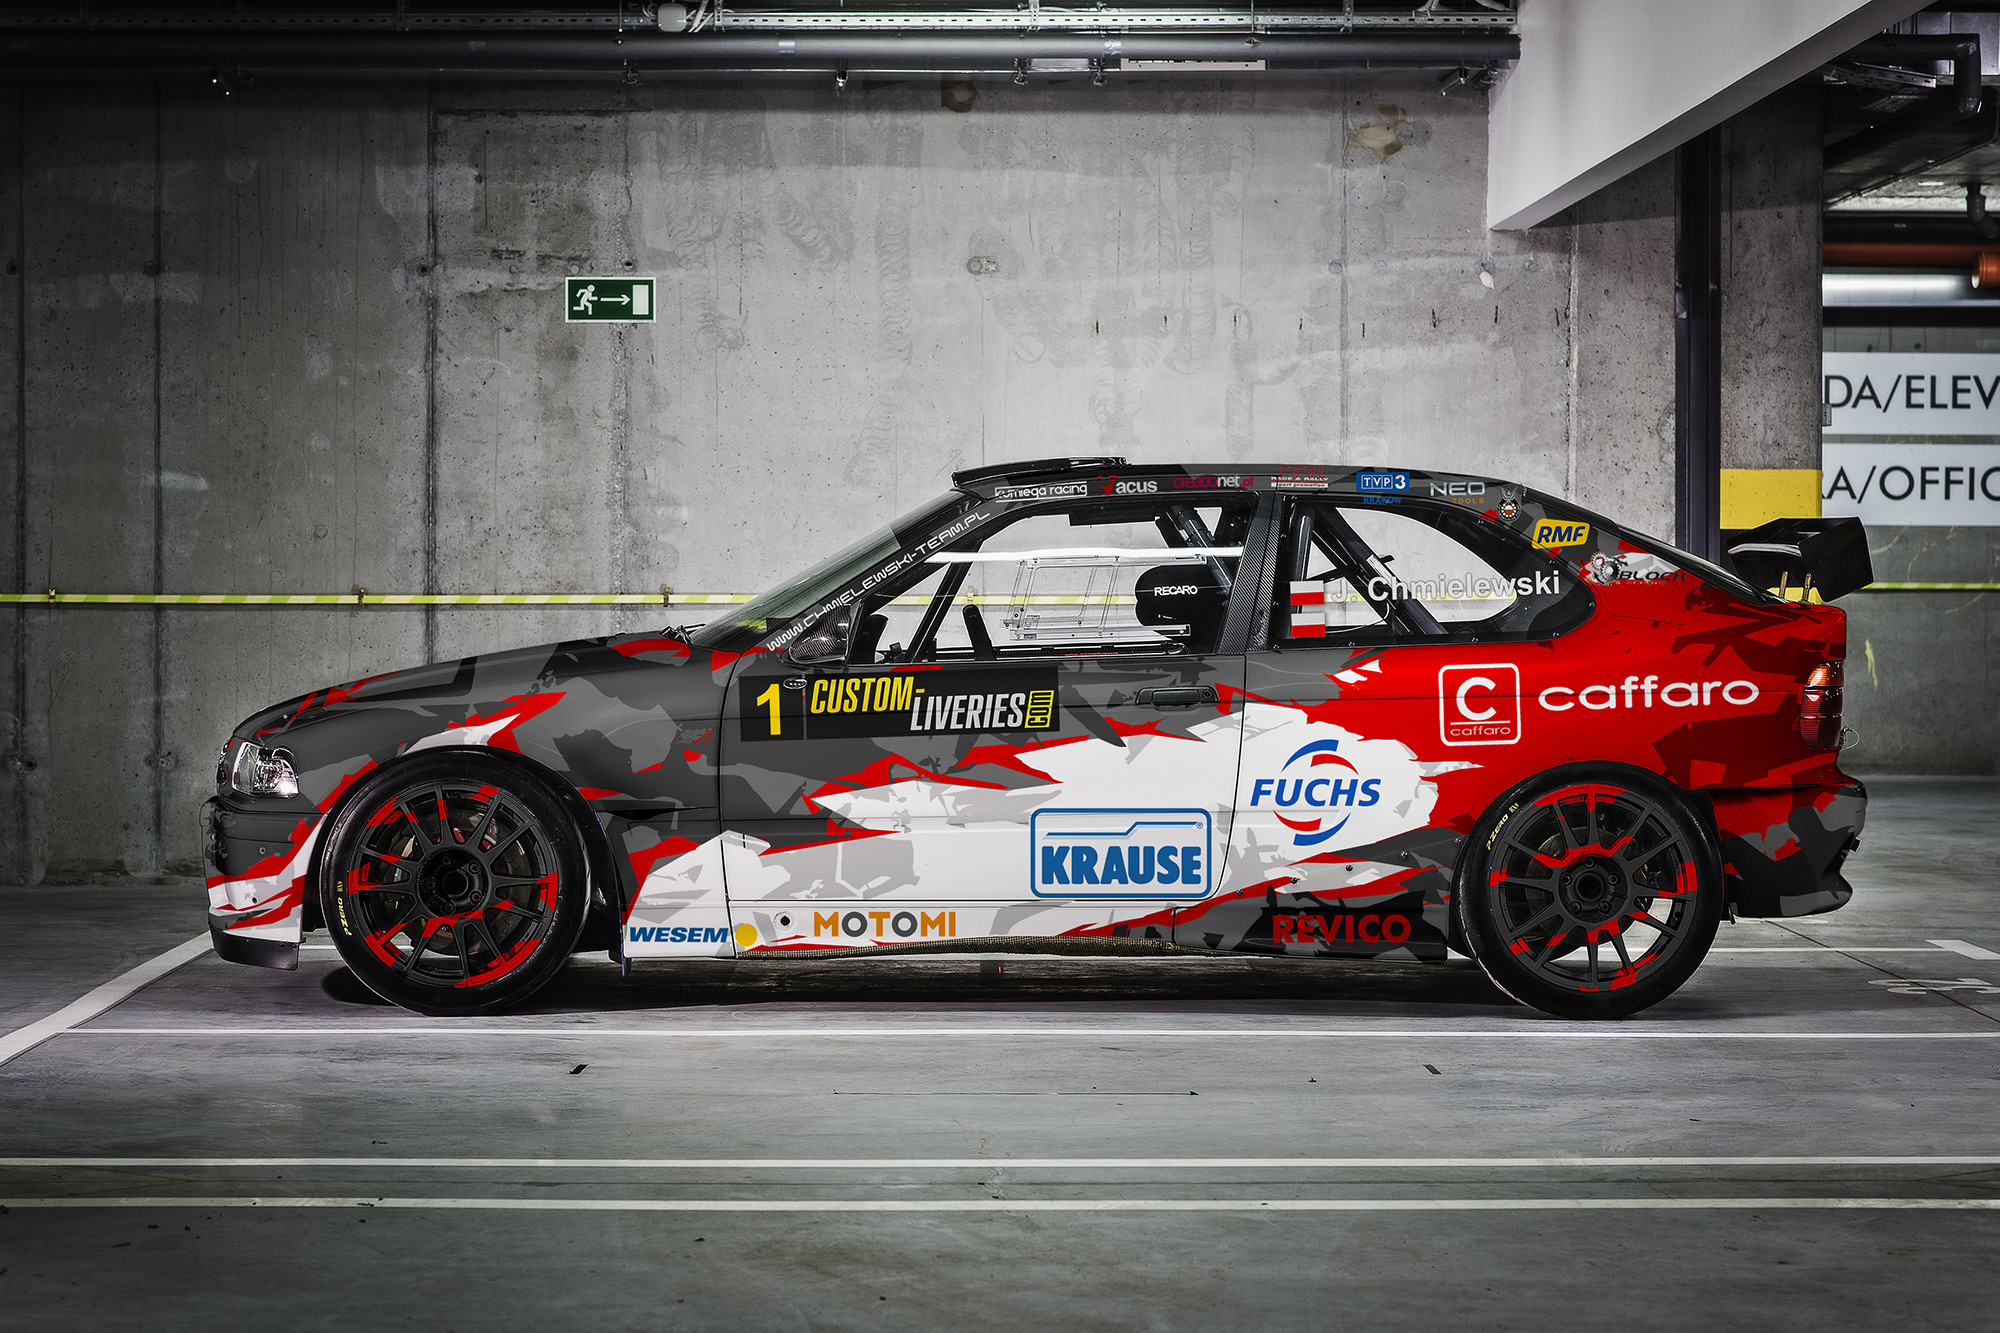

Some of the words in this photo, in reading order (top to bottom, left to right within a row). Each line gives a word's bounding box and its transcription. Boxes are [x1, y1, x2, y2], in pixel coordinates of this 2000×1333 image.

[1049, 483, 1088, 498] racing
[1430, 482, 1486, 496] NEO
[1537, 526, 1586, 543] RMF
[767, 511, 990, 651] WWW.CHMIELEWSKI-TEAM.PL
[1154, 585, 1198, 596] RECARO
[1331, 578, 1357, 603] J.
[1367, 570, 1560, 601] Chmielewski
[1538, 675, 1760, 711] caffaro
[756, 683, 782, 735] 1
[910, 692, 1026, 731] LIVERIES
[1450, 725, 1511, 736] caffaro
[1250, 778, 1382, 807] FUCHS
[1041, 845, 1202, 885] KRAUSE
[629, 927, 728, 943] WESEM
[813, 911, 956, 938] MOTOMI
[1272, 914, 1412, 943] REVICO
